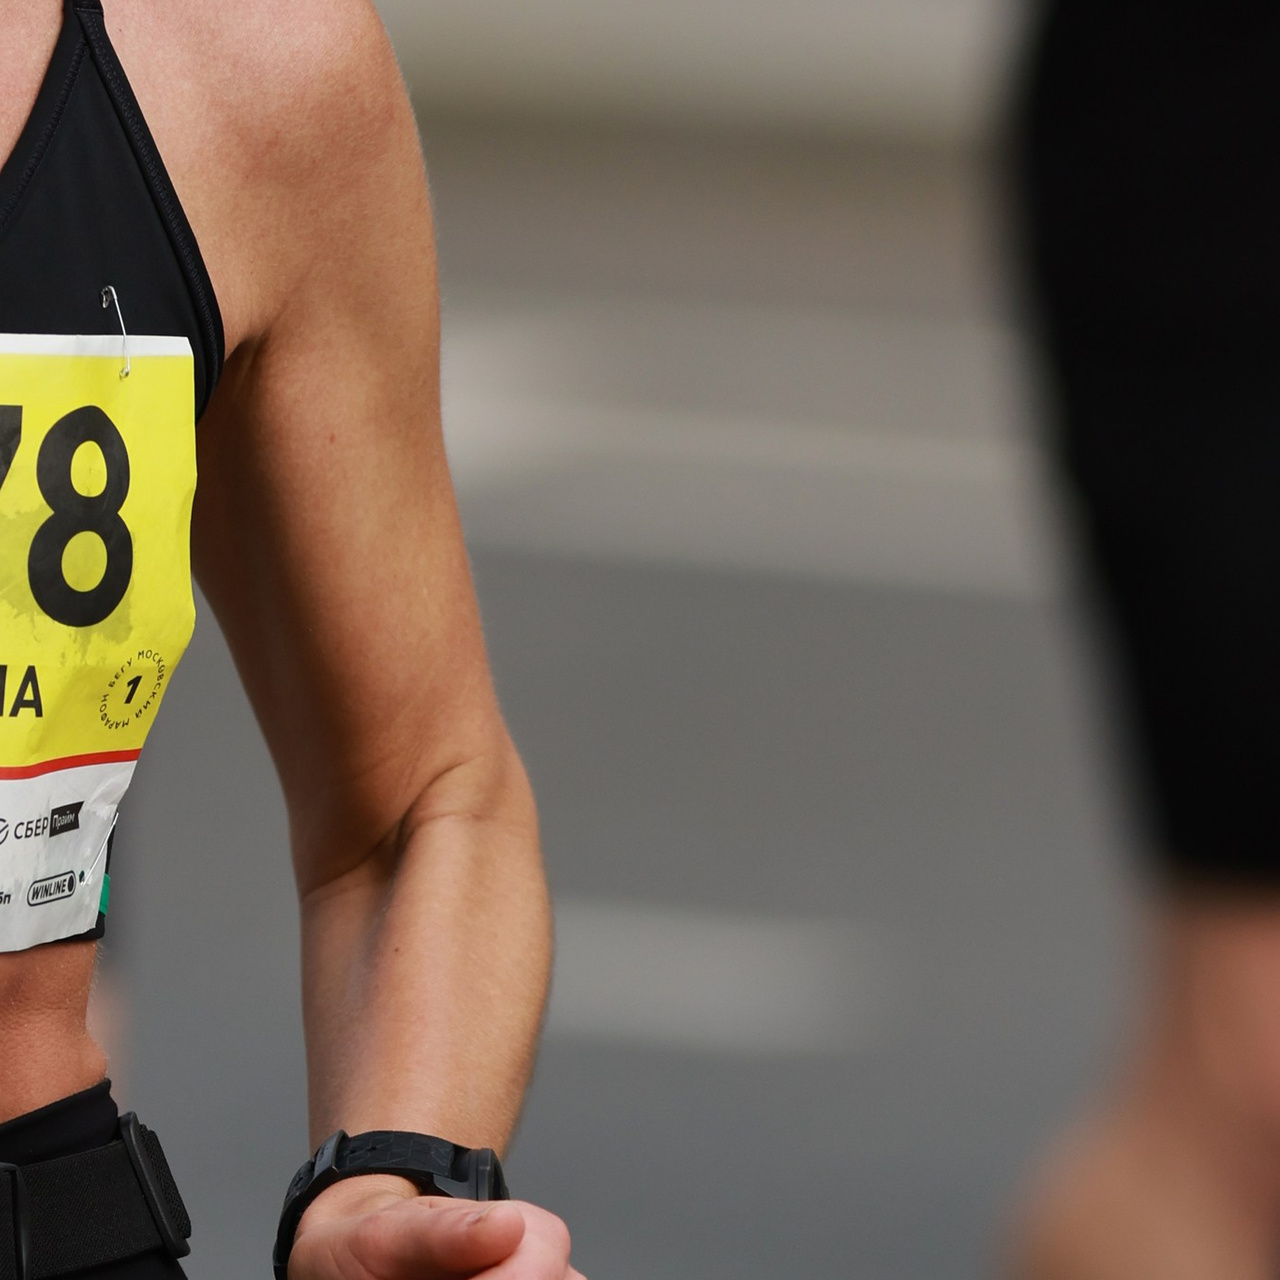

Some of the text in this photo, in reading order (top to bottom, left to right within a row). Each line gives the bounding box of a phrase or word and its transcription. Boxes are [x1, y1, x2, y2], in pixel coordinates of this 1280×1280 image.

[108, 657, 132, 688] БЕГУ
[124, 675, 143, 705] 1
[14, 816, 49, 840] СБЕР
[31, 878, 68, 901] WINLINE
